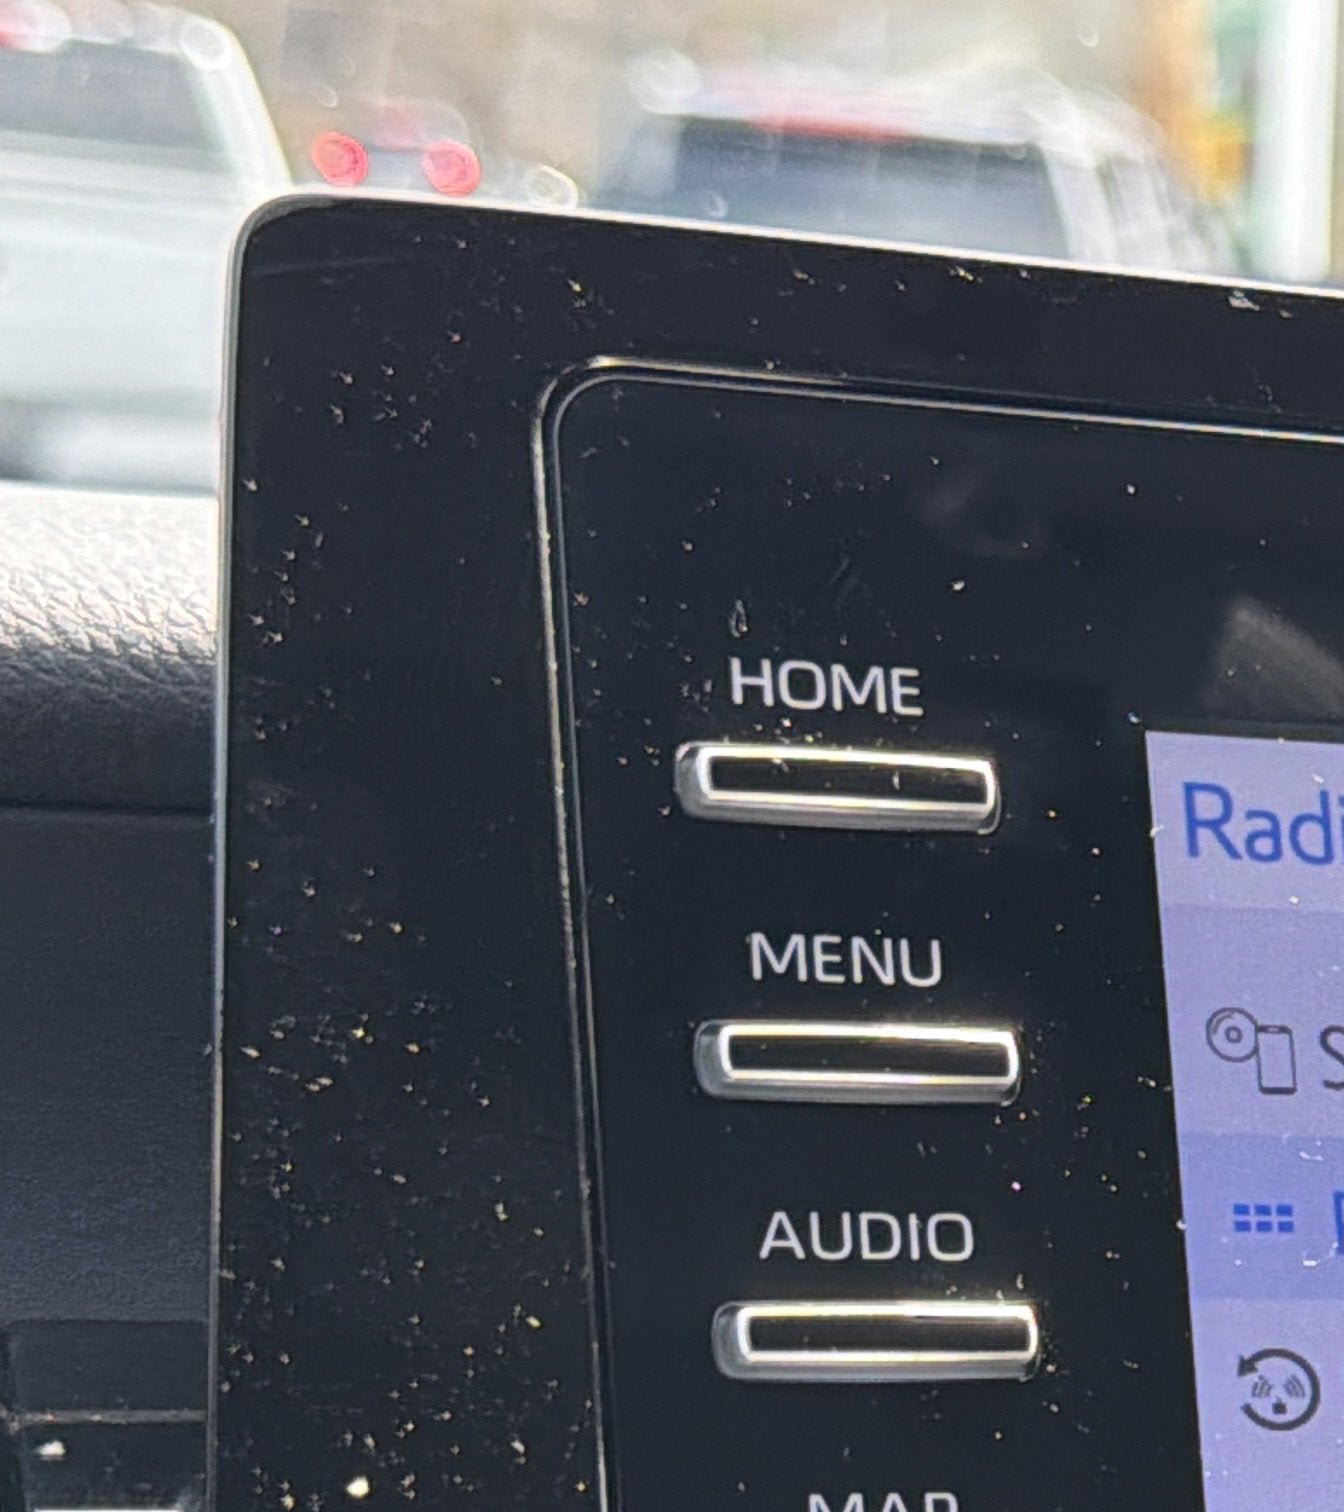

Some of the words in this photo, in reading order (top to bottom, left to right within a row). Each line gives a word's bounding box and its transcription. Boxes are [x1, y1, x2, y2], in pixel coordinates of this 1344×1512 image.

[729, 657, 924, 717] HOME
[749, 933, 944, 987] MENU
[759, 1211, 975, 1263] AUDIO
